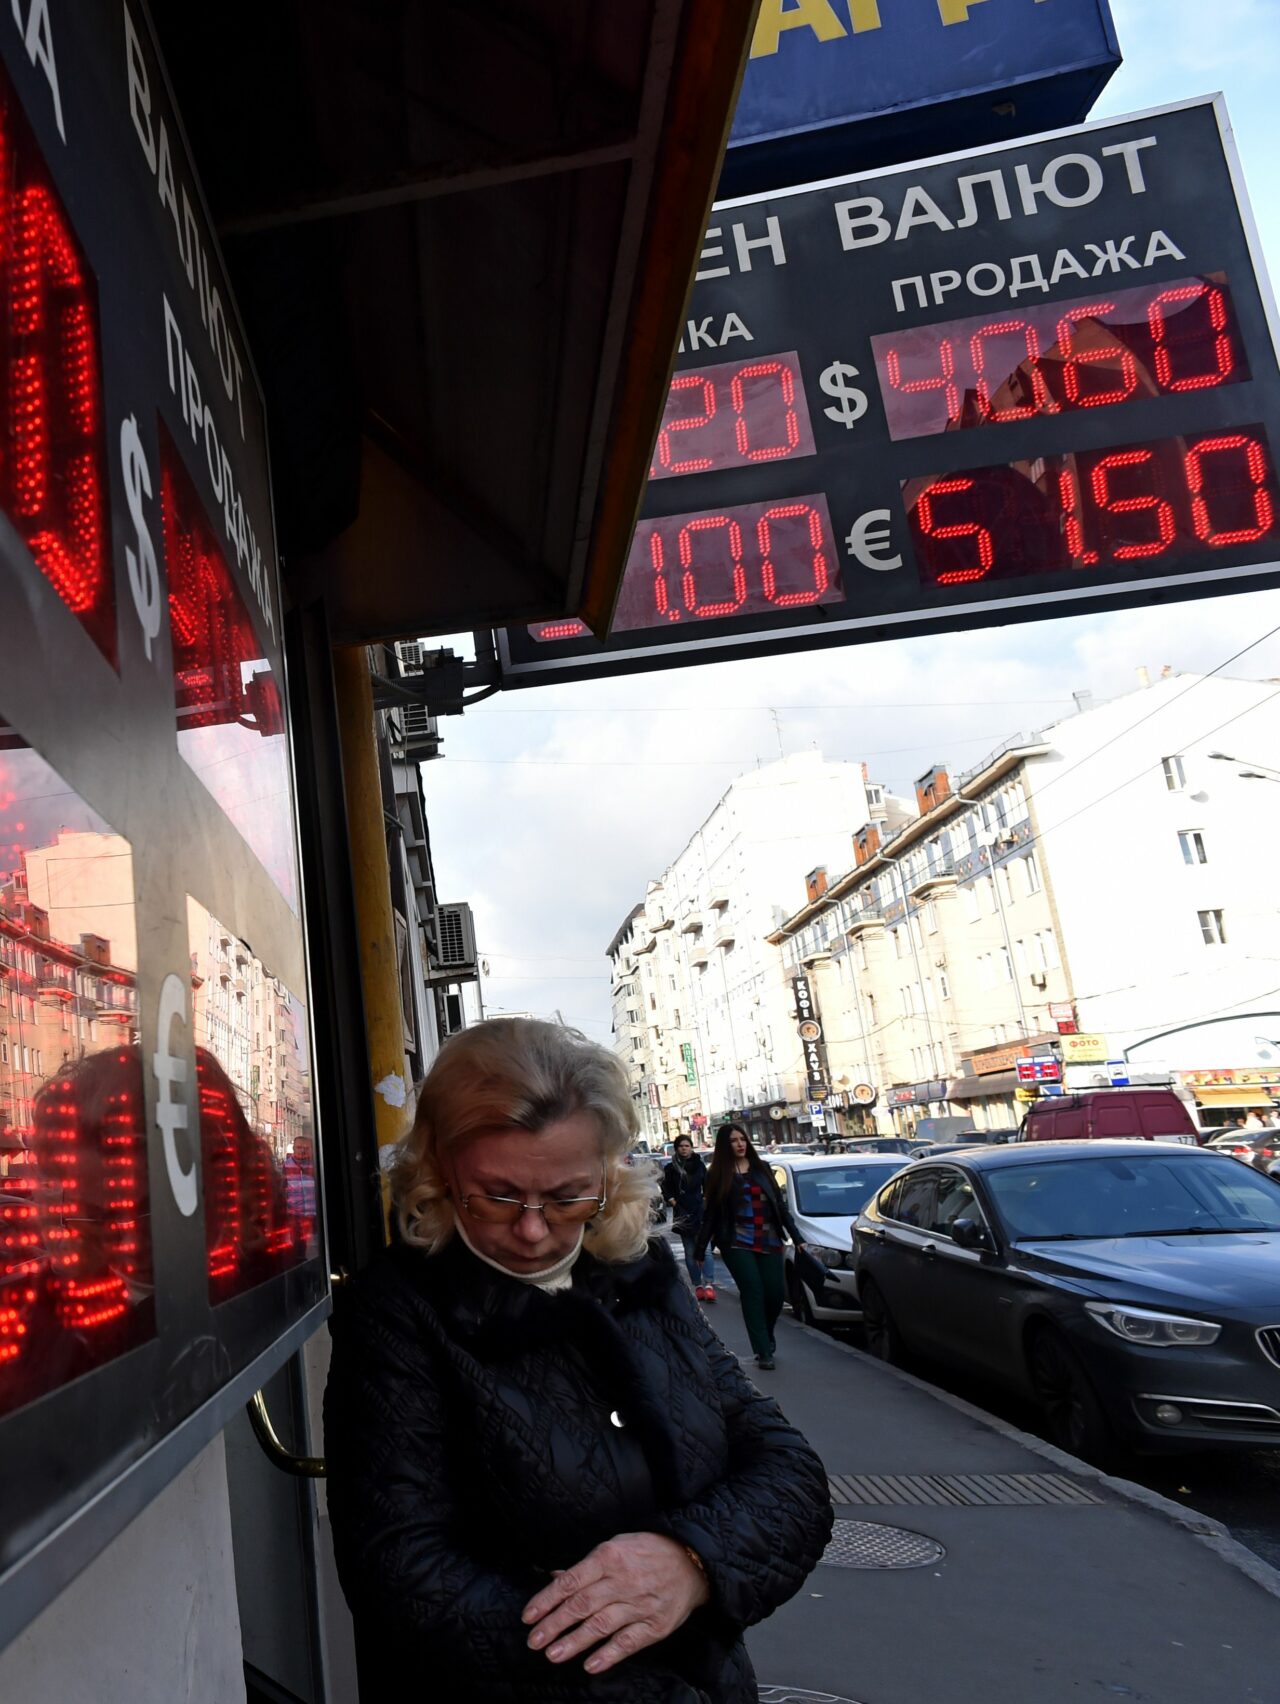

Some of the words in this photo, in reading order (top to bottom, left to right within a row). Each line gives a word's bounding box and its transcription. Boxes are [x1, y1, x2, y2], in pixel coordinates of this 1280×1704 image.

[124, 6, 245, 441] ВАЛЮТ
[835, 136, 1157, 252] ВАЛЮТ
[891, 229, 1186, 311] ПРОДАЖА
[819, 360, 869, 430] $
[163, 292, 276, 646] ПРОДАЖА
[121, 412, 160, 661] $
[845, 509, 904, 571] €
[796, 981, 810, 1018] КОФЕ
[1070, 1039, 1099, 1048] ФОТО
